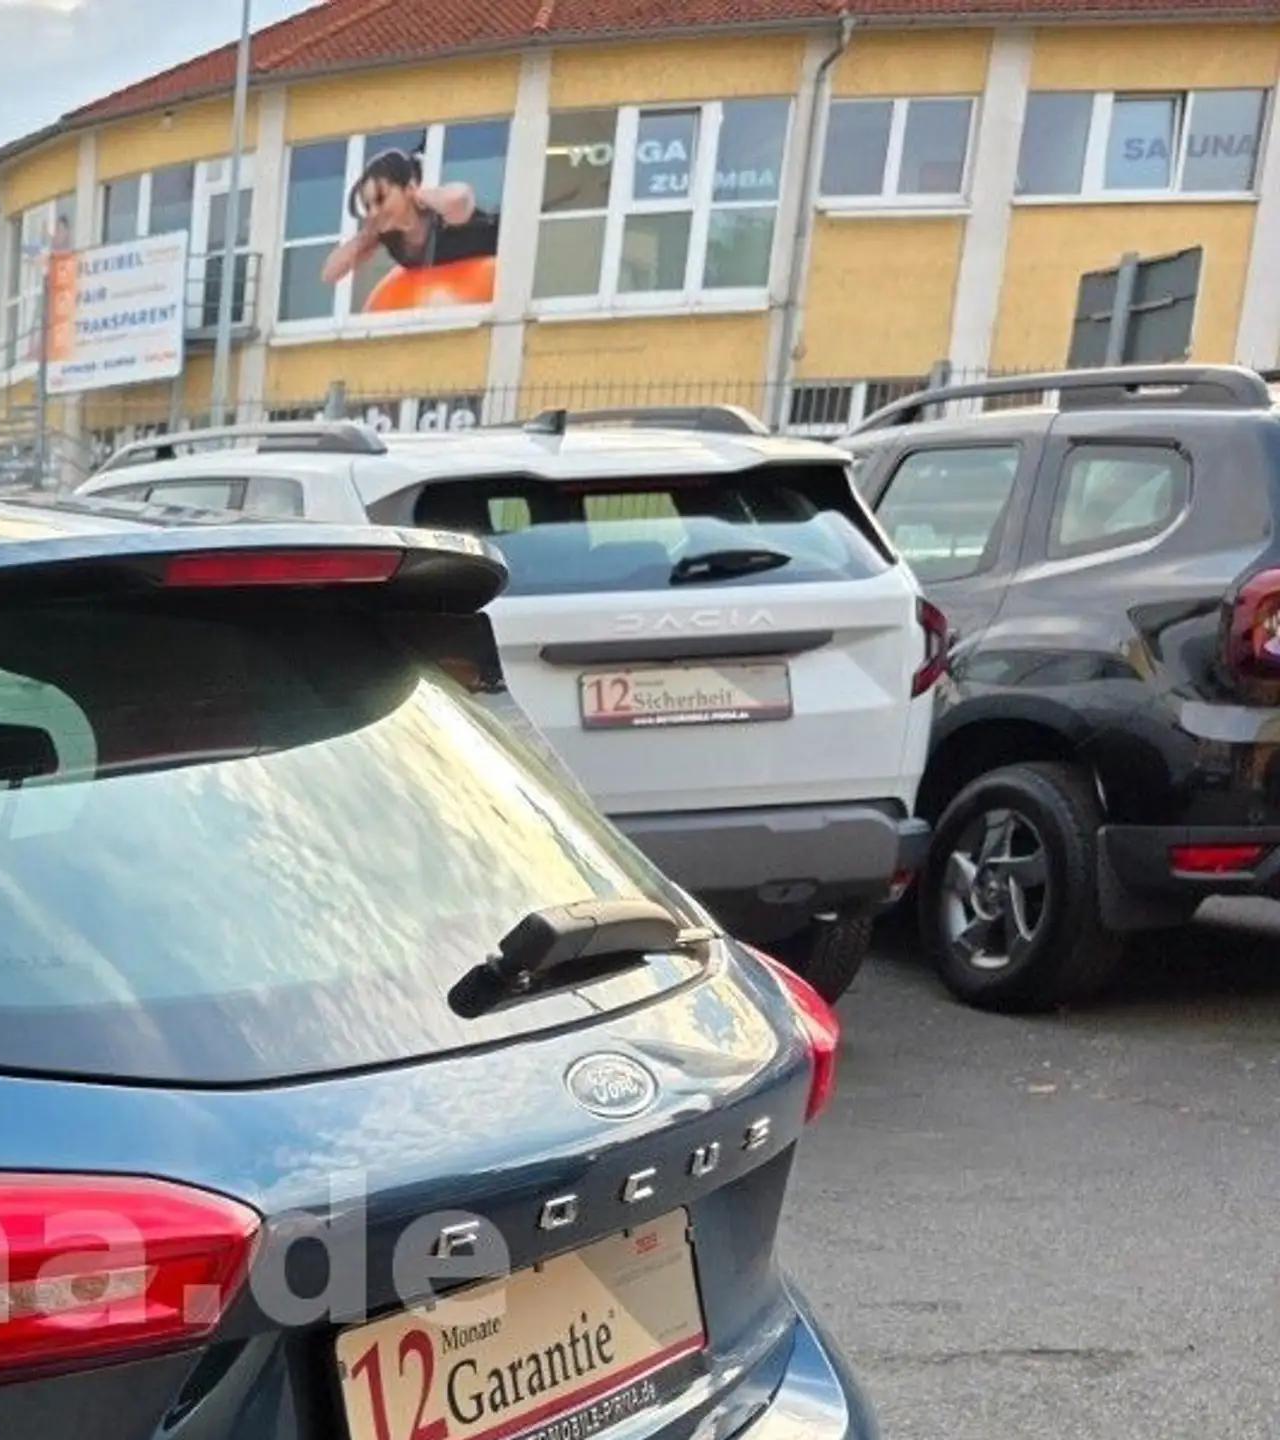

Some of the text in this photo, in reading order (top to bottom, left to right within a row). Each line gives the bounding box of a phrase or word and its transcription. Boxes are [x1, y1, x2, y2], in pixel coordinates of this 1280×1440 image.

[566, 139, 688, 168] YOGA
[1122, 133, 1255, 161] SAUNA
[648, 167, 777, 194] ZUMBA
[75, 303, 177, 333] TRANSPARENT
[613, 608, 776, 635] DACIA
[587, 677, 733, 714] 12 Sicherheit
[433, 1116, 772, 1259] FOCUS
[440, 1316, 503, 1354] Monate
